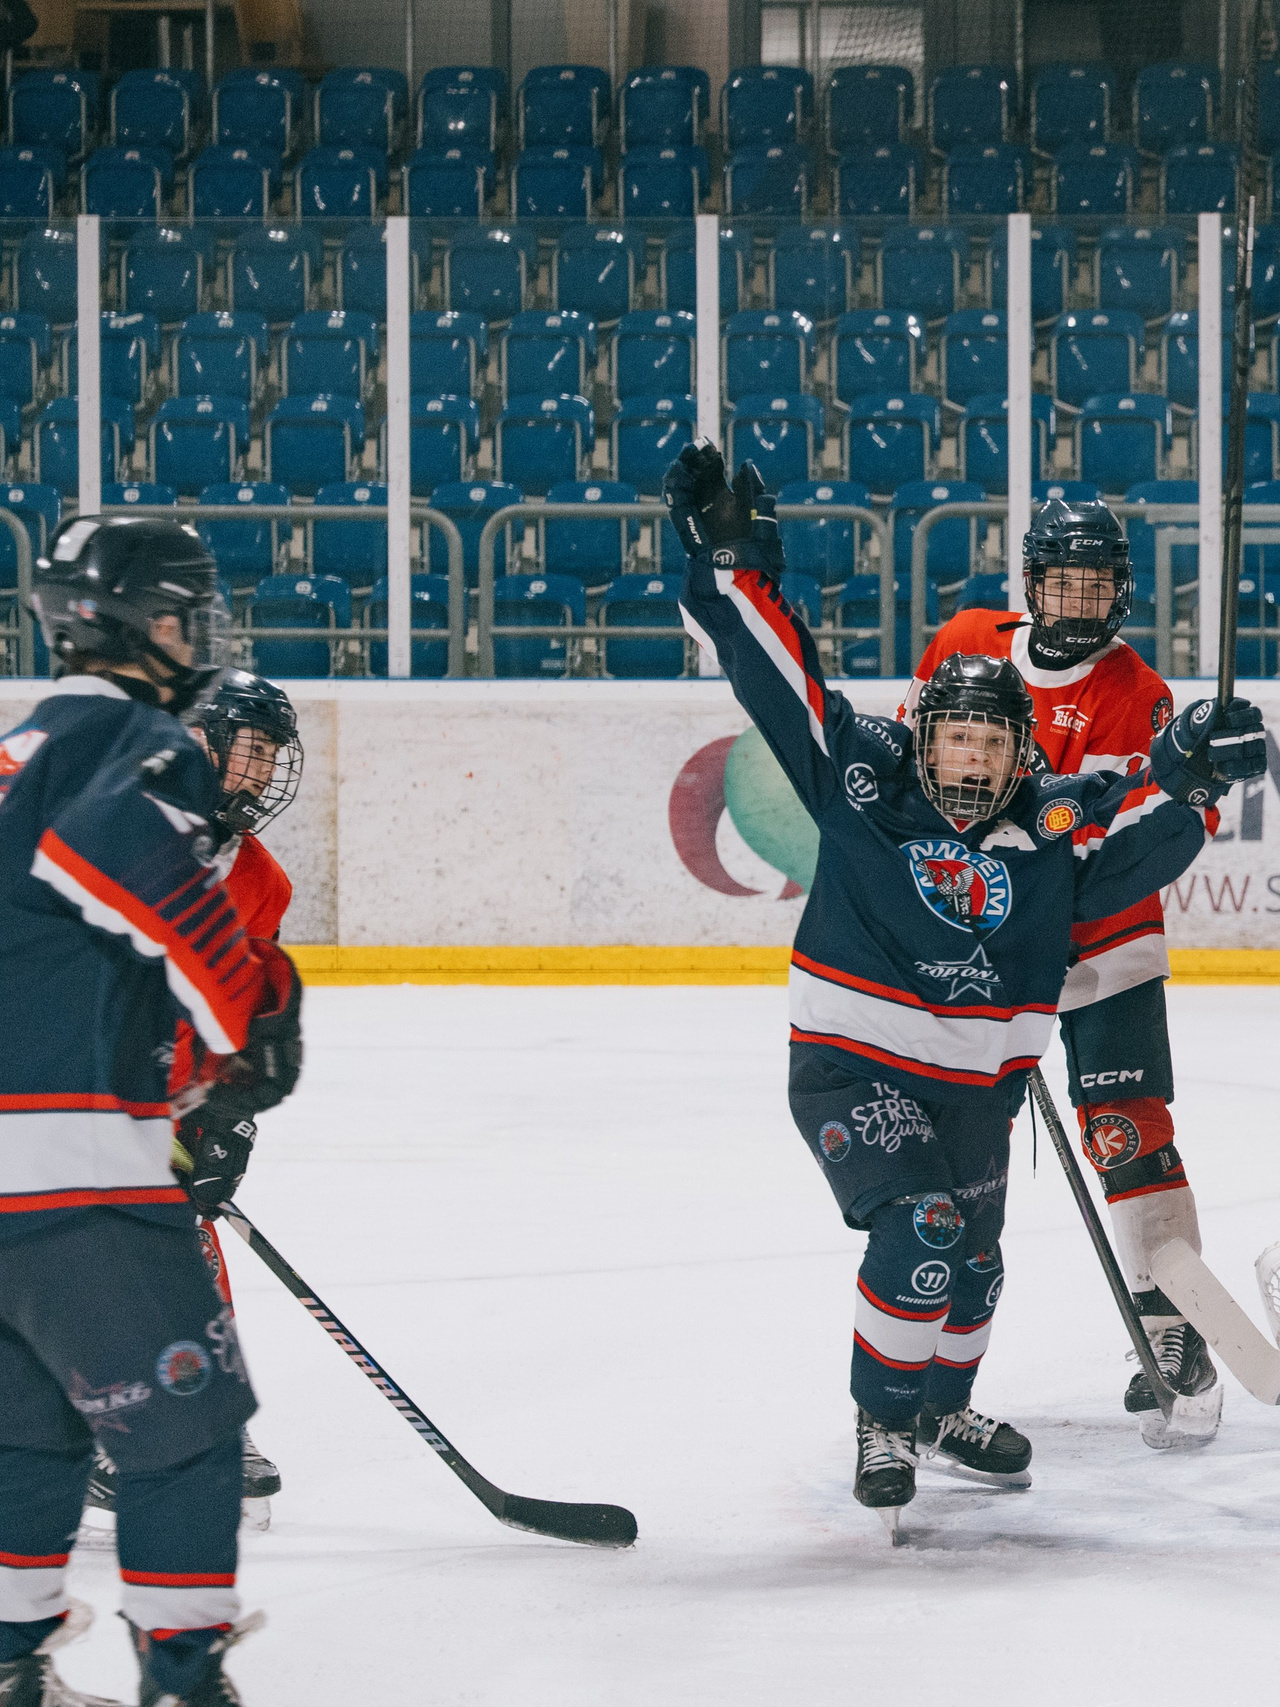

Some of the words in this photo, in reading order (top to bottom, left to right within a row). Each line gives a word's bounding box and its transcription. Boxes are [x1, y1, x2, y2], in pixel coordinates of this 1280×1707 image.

[1069, 538, 1104, 551] CCM
[1079, 1069, 1144, 1088] CCM
[851, 1098, 933, 1132] STREE
